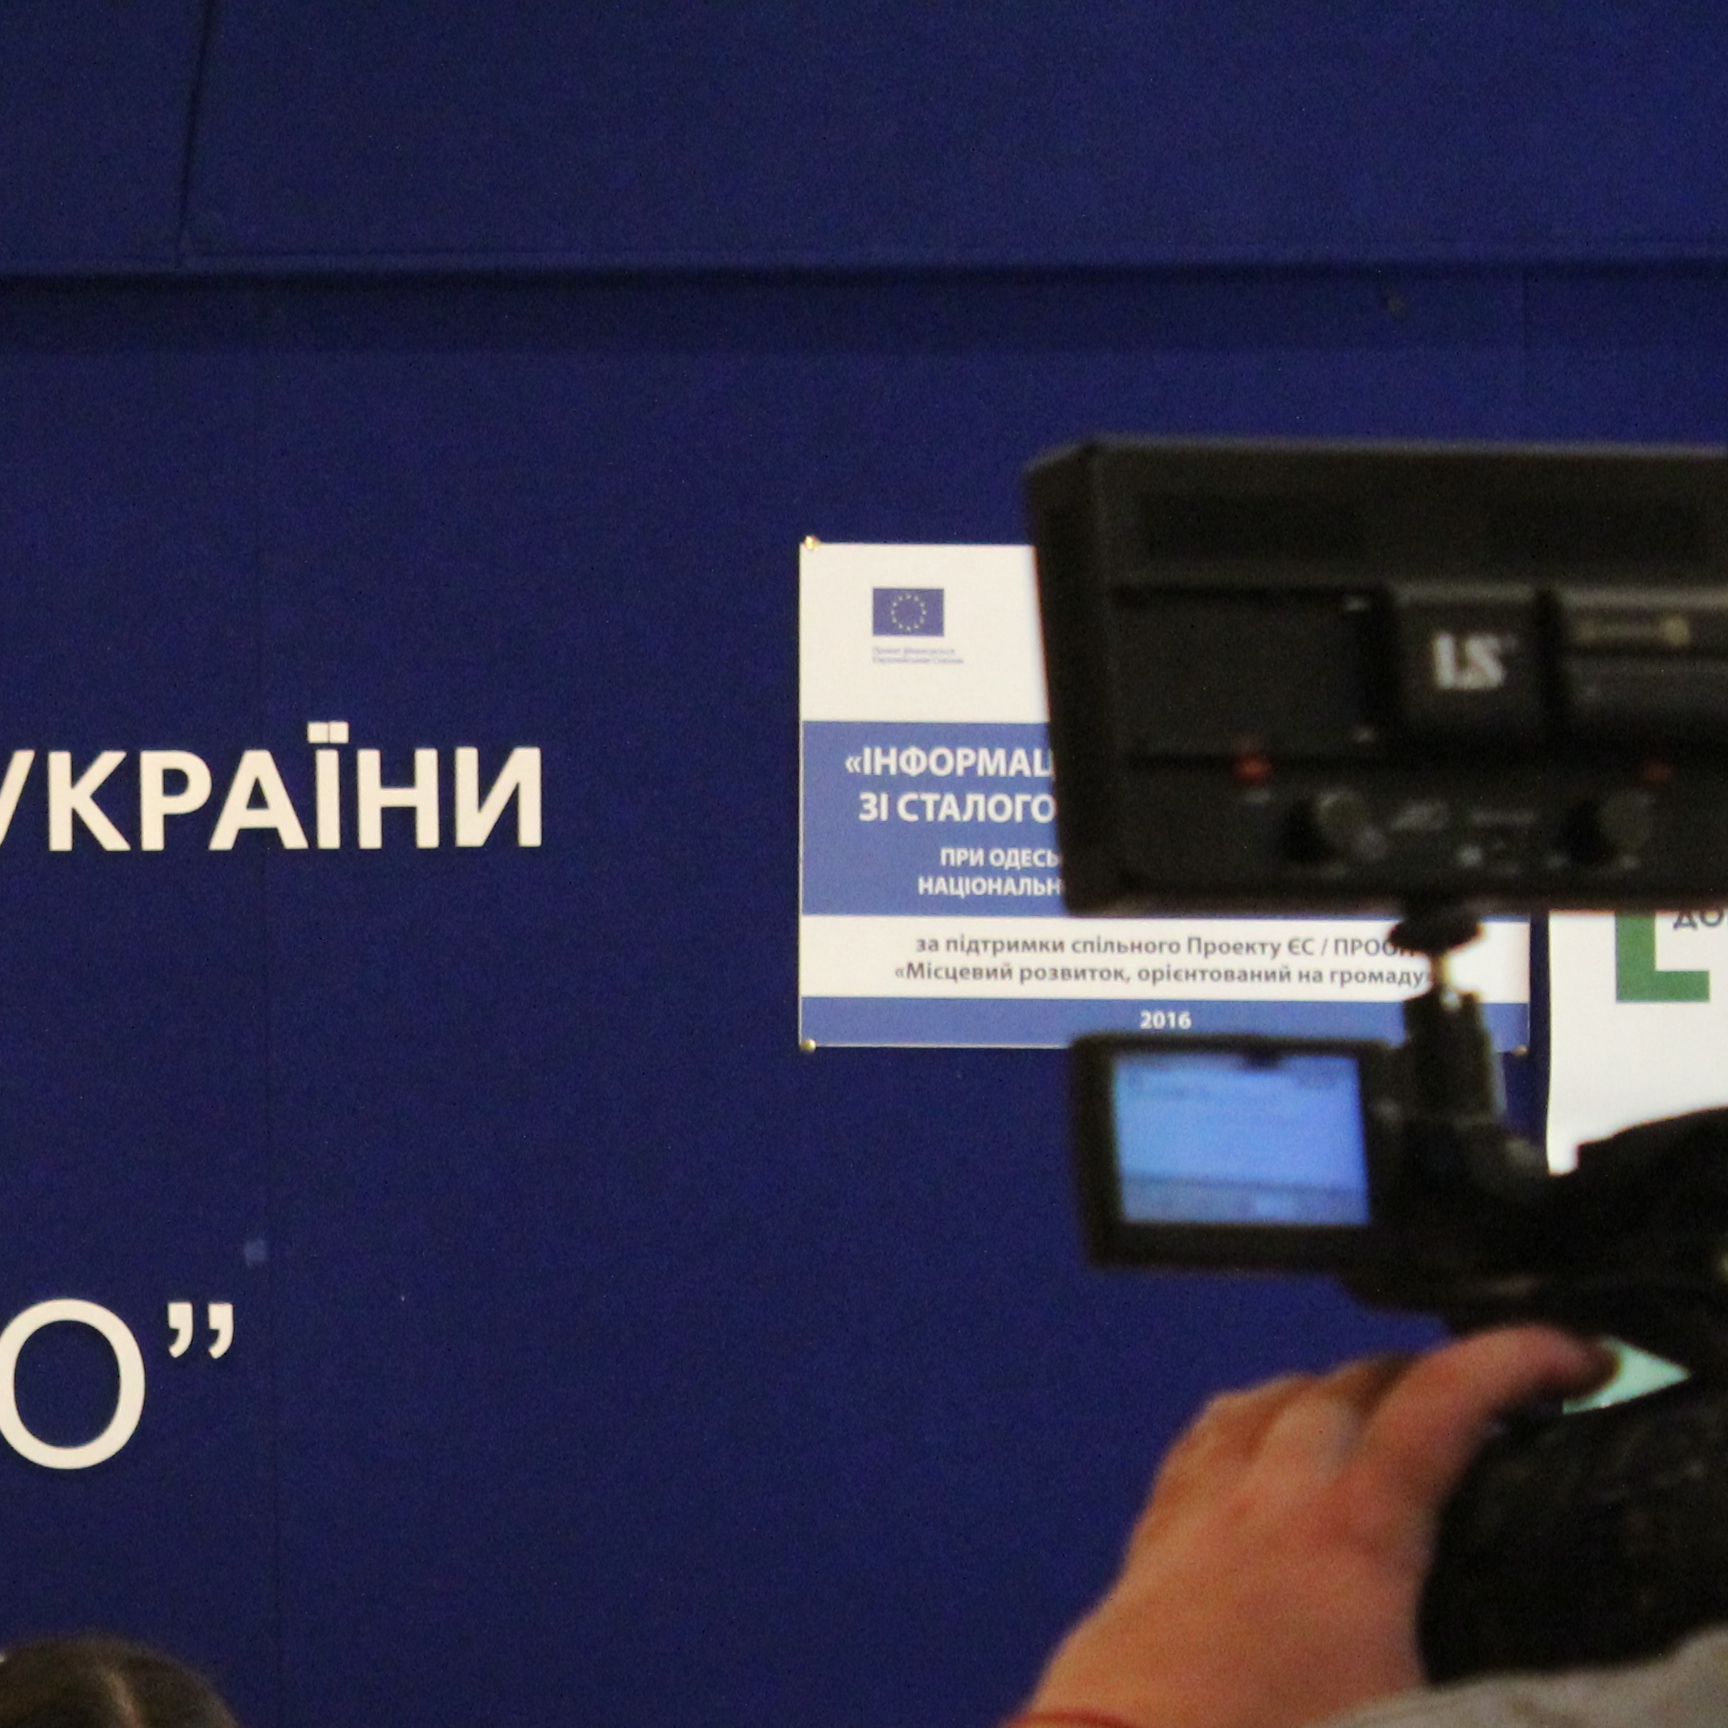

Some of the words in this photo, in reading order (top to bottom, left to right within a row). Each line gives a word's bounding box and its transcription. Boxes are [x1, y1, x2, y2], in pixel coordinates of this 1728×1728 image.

[845, 746, 1055, 779] «ІНФОРМАЦ
[858, 791, 889, 822] ЗІ
[897, 792, 1056, 823] СТАЛОГО
[940, 847, 985, 867] ПРИ
[989, 848, 1060, 870] ОДЕСЬ
[917, 876, 1062, 899] НАЦІОНАЛЬН
[916, 937, 939, 953] за
[946, 934, 1065, 957] підтримки
[1071, 935, 1181, 954] спільного
[1187, 937, 1281, 959] Проекту
[1287, 938, 1315, 956] ЄС
[1320, 938, 1329, 957] /
[1334, 938, 1414, 957] ПРОО
[894, 962, 1013, 983] «Місцевий
[1019, 967, 1131, 986] розвиток,
[1138, 965, 1292, 987] орієнтований
[1298, 969, 1323, 983] на
[1139, 1010, 1192, 1030] 2016
